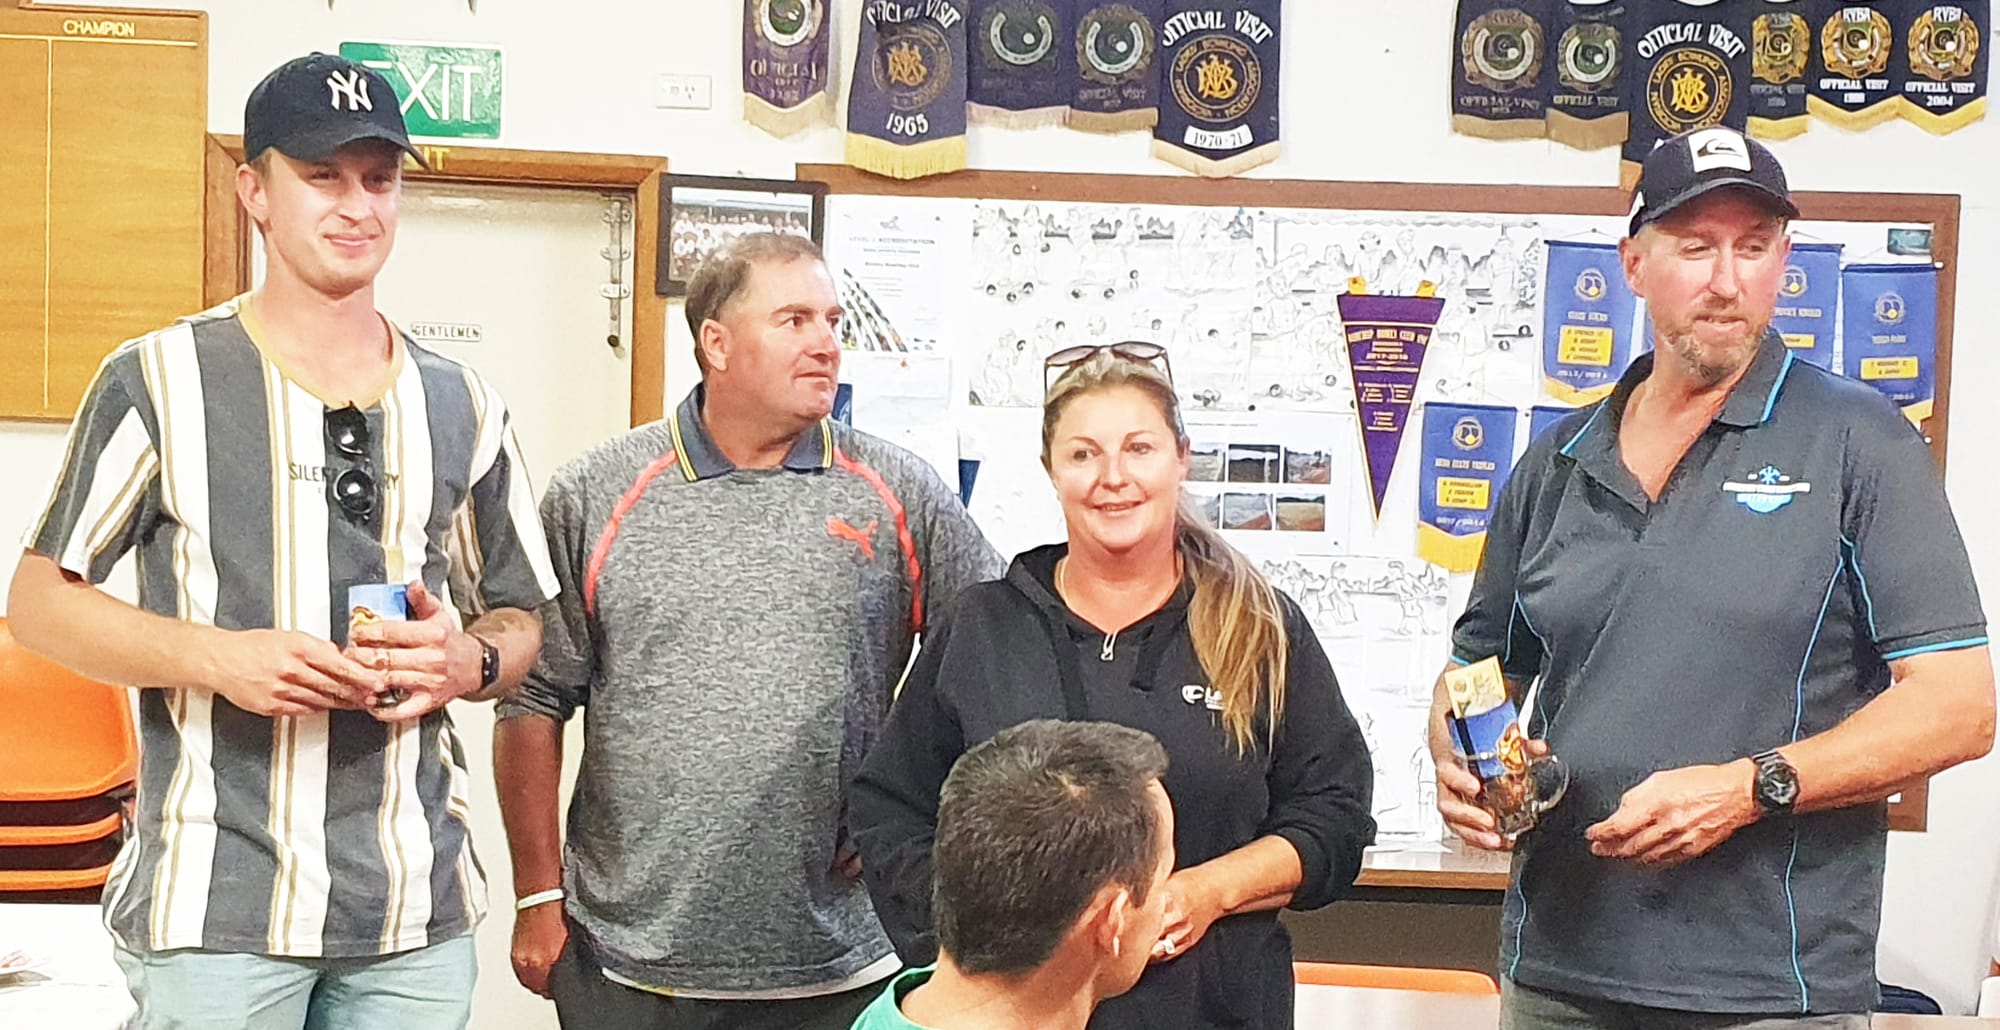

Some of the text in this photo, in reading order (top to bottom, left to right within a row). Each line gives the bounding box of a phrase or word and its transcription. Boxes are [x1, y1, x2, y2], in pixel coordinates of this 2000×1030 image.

[63, 20, 135, 36] CHAMPION
[1234, 9, 1273, 44] VISIT
[1637, 22, 1746, 59] OFFICIAL VISIT
[327, 69, 373, 112] NY
[361, 60, 482, 122] XIT
[1926, 95, 1953, 107] 2004
[886, 112, 928, 136] 1965
[412, 325, 479, 338] GENTLEMEN
